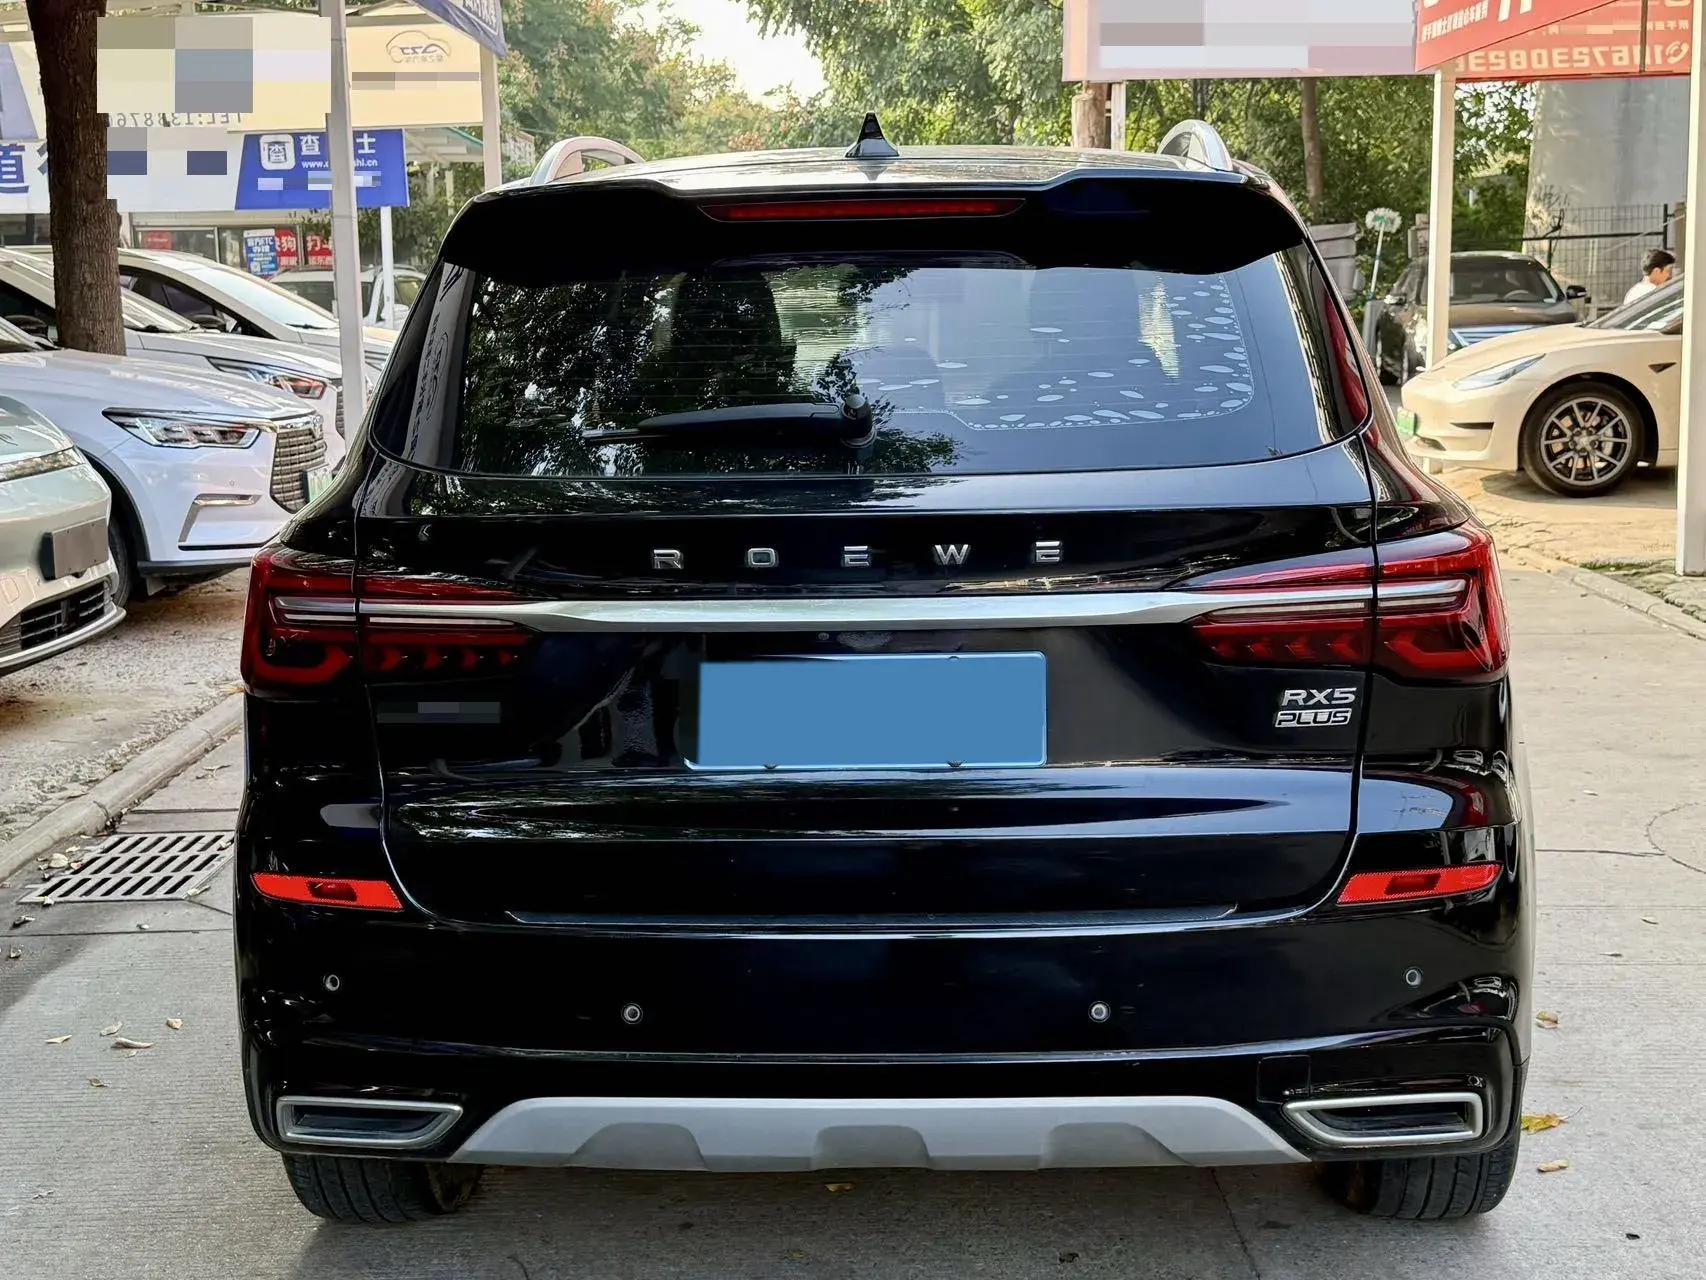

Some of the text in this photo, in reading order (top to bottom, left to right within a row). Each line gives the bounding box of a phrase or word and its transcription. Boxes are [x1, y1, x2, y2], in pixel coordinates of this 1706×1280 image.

[300, 133, 376, 155] 查士
[653, 541, 1061, 568] ROEWE
[1281, 688, 1357, 706] RX5
[1275, 708, 1352, 727] PLUS
